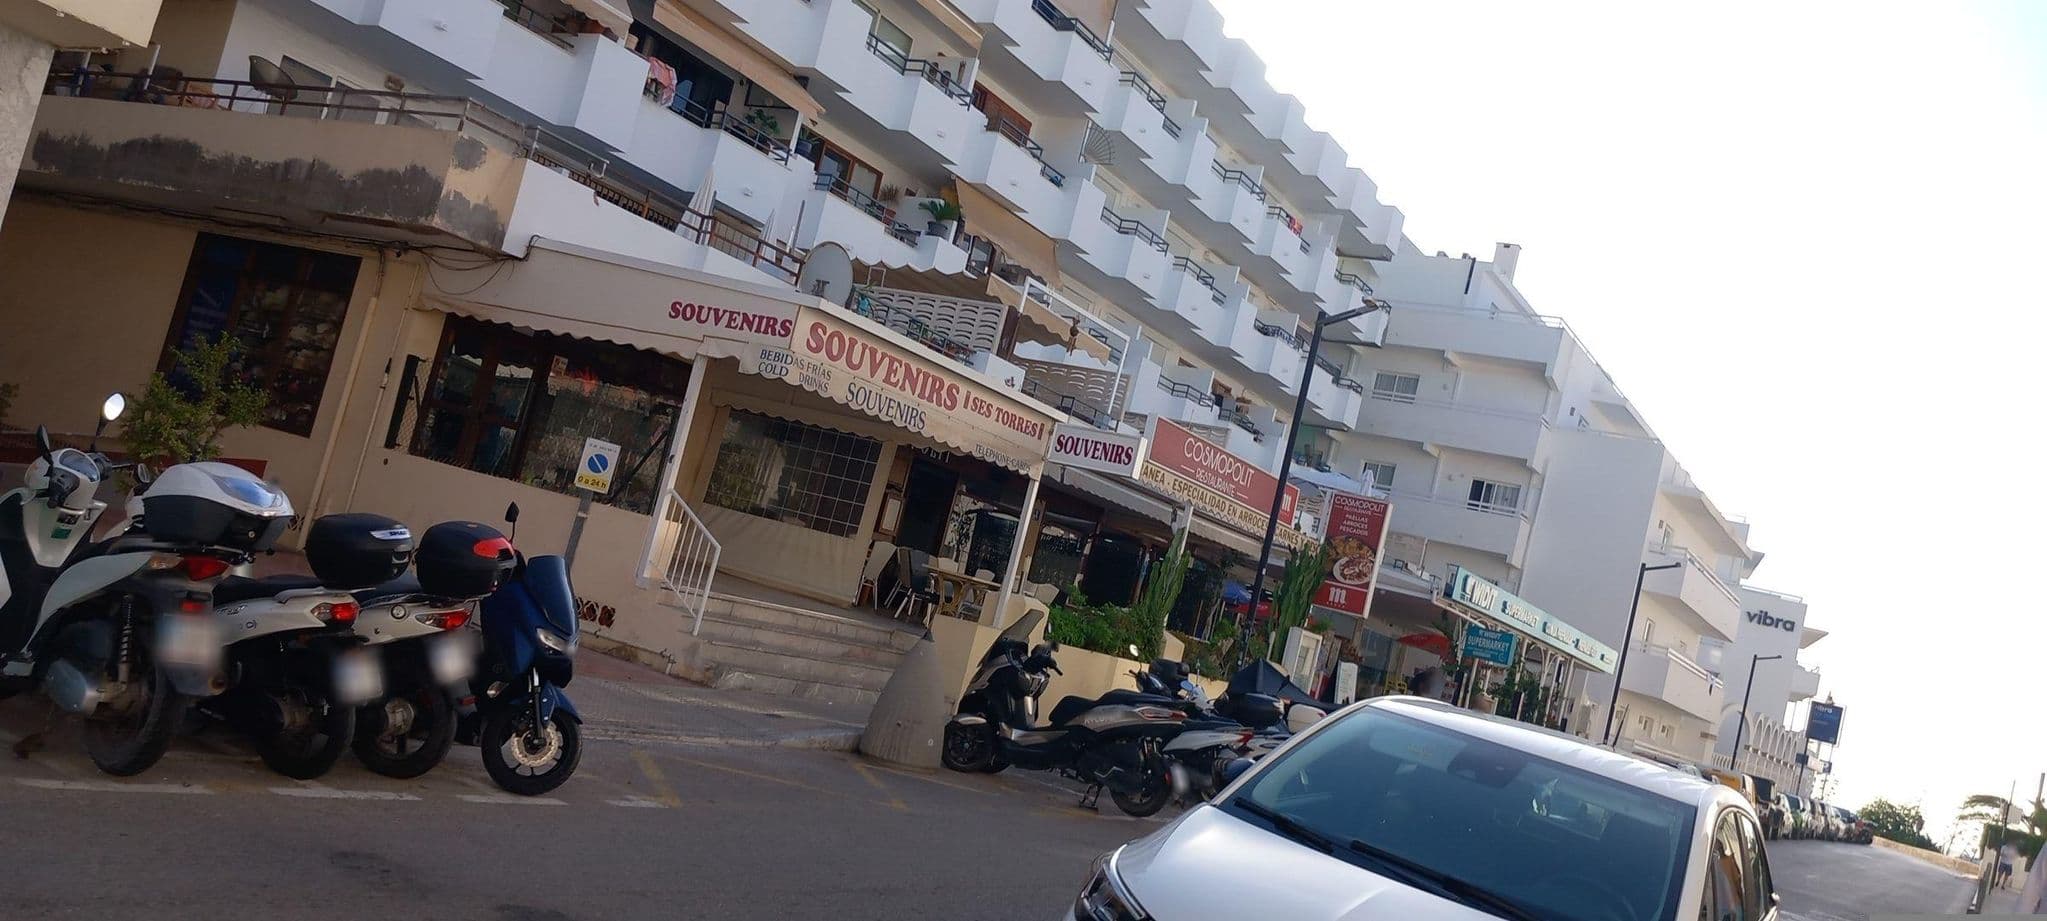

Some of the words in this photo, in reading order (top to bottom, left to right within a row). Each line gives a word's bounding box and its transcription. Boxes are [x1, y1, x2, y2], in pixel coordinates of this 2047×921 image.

[668, 301, 793, 338] SOUVENIRS
[759, 361, 789, 377] COLD
[760, 349, 805, 370] BEBIDAS
[806, 321, 960, 411] SOUVENIRS
[799, 372, 830, 393] DRINKS
[846, 382, 927, 430] SOUVENIRS
[971, 396, 995, 419] SES
[995, 407, 1038, 438] TORRES
[1055, 433, 1134, 466] SOUVENIRS
[1184, 437, 1255, 489] COSMOPOLIT
[590, 478, 600, 487] 24
[601, 481, 607, 489] h
[1172, 478, 1226, 512] ESPECIALIDAD
[1227, 503, 1237, 518] EN
[1195, 468, 1237, 498] RESTAURANTE
[1334, 496, 1385, 513] COSMOPOLIT
[1746, 610, 1796, 632] vibra
